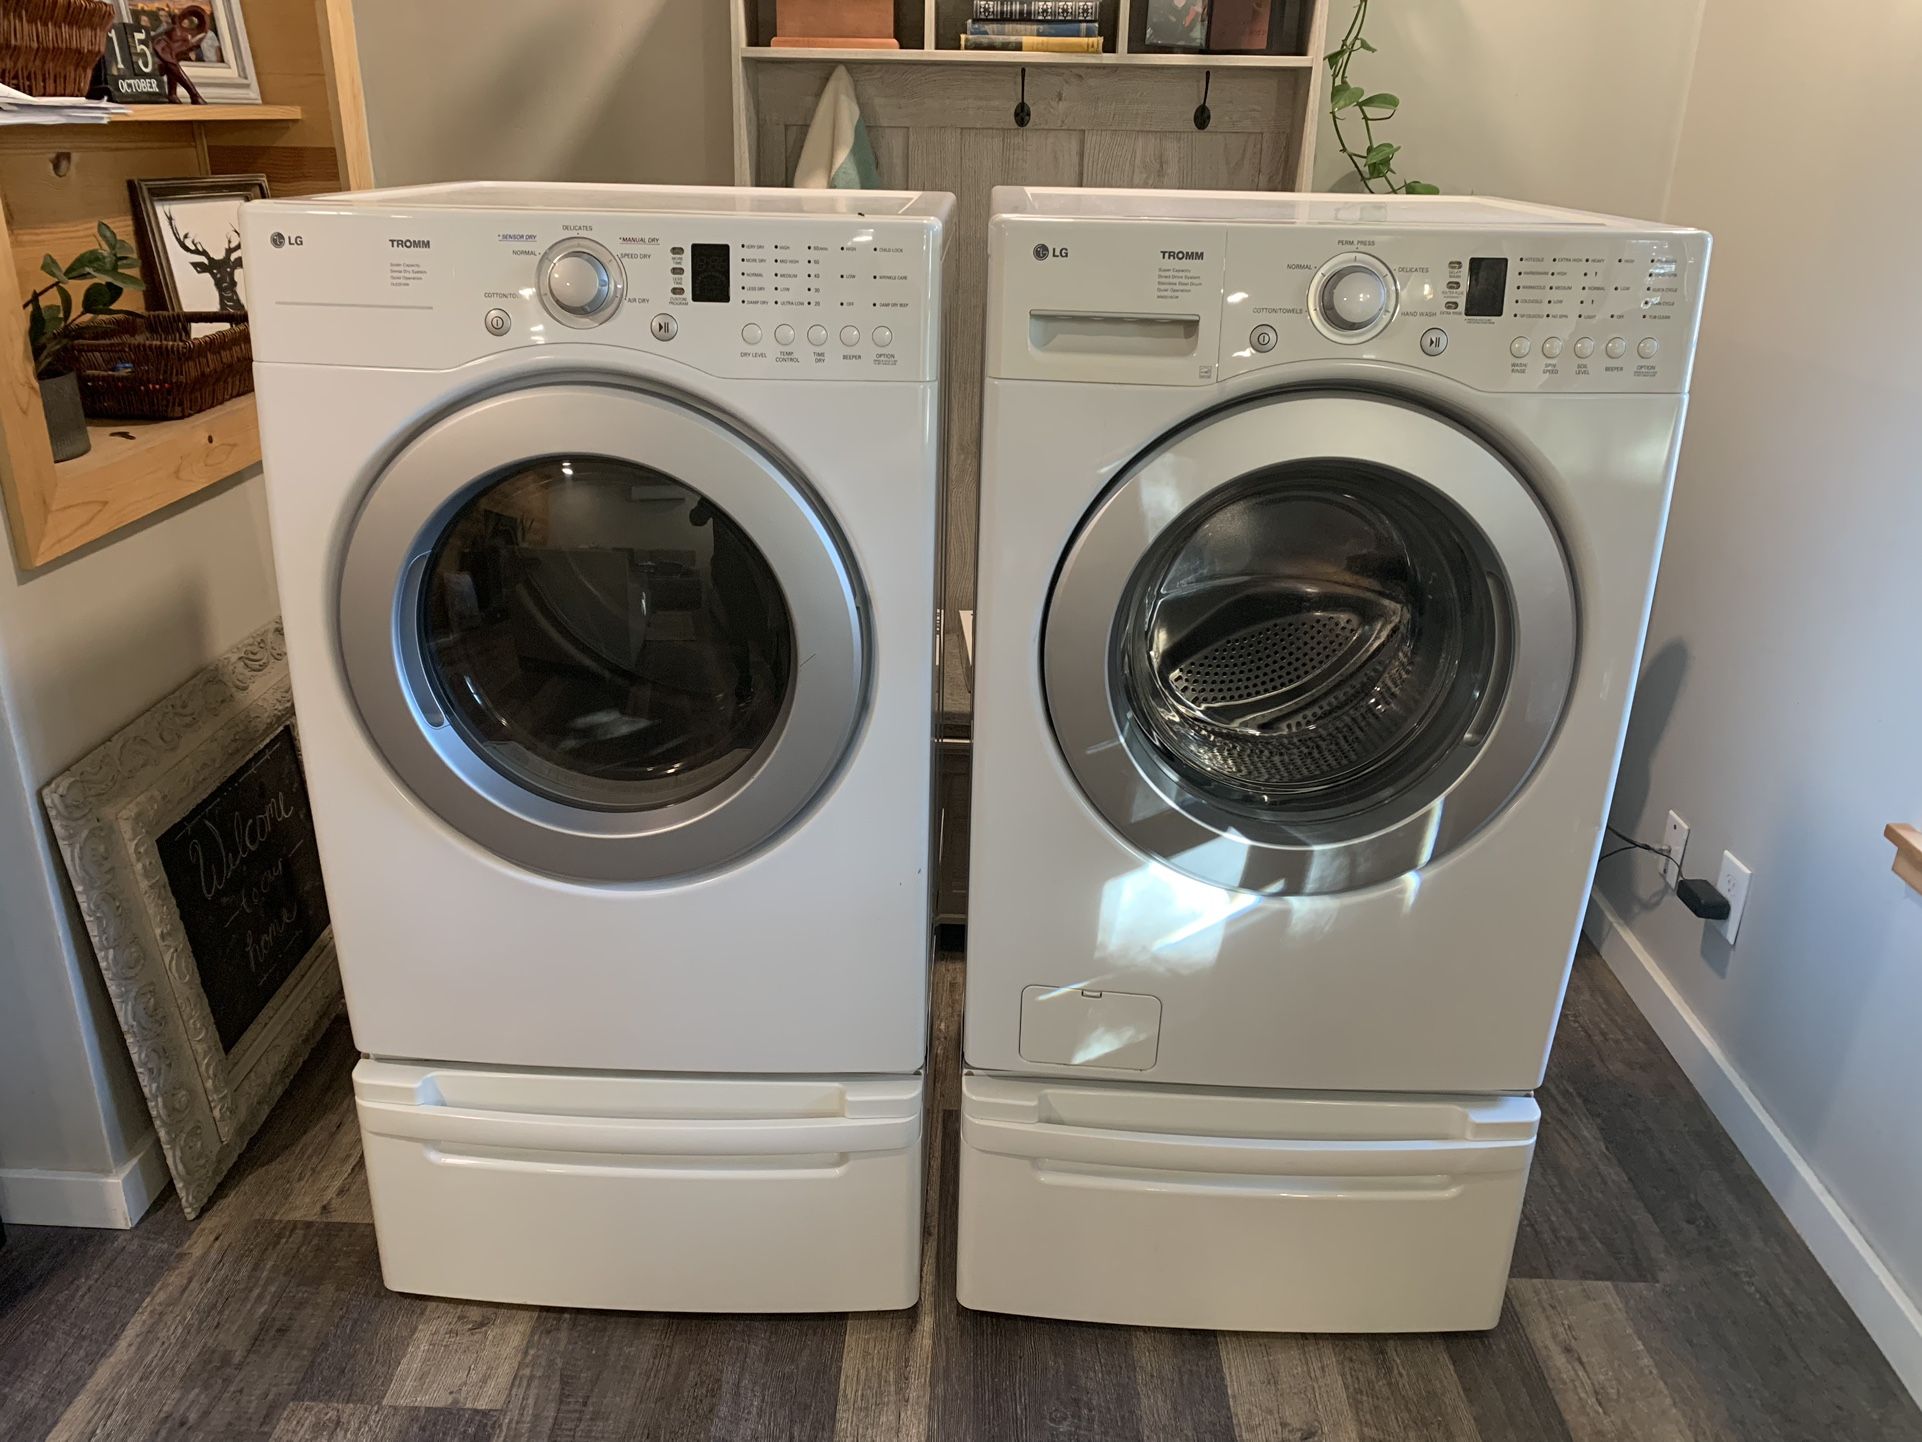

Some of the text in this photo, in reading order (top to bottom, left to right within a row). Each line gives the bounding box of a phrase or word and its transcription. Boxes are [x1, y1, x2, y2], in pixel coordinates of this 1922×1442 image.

[118, 78, 159, 93] OCTOBER
[389, 239, 431, 249] TROMM
[1160, 250, 1204, 261] TROMM
[189, 791, 294, 900] Welcome
[244, 901, 298, 973] home
